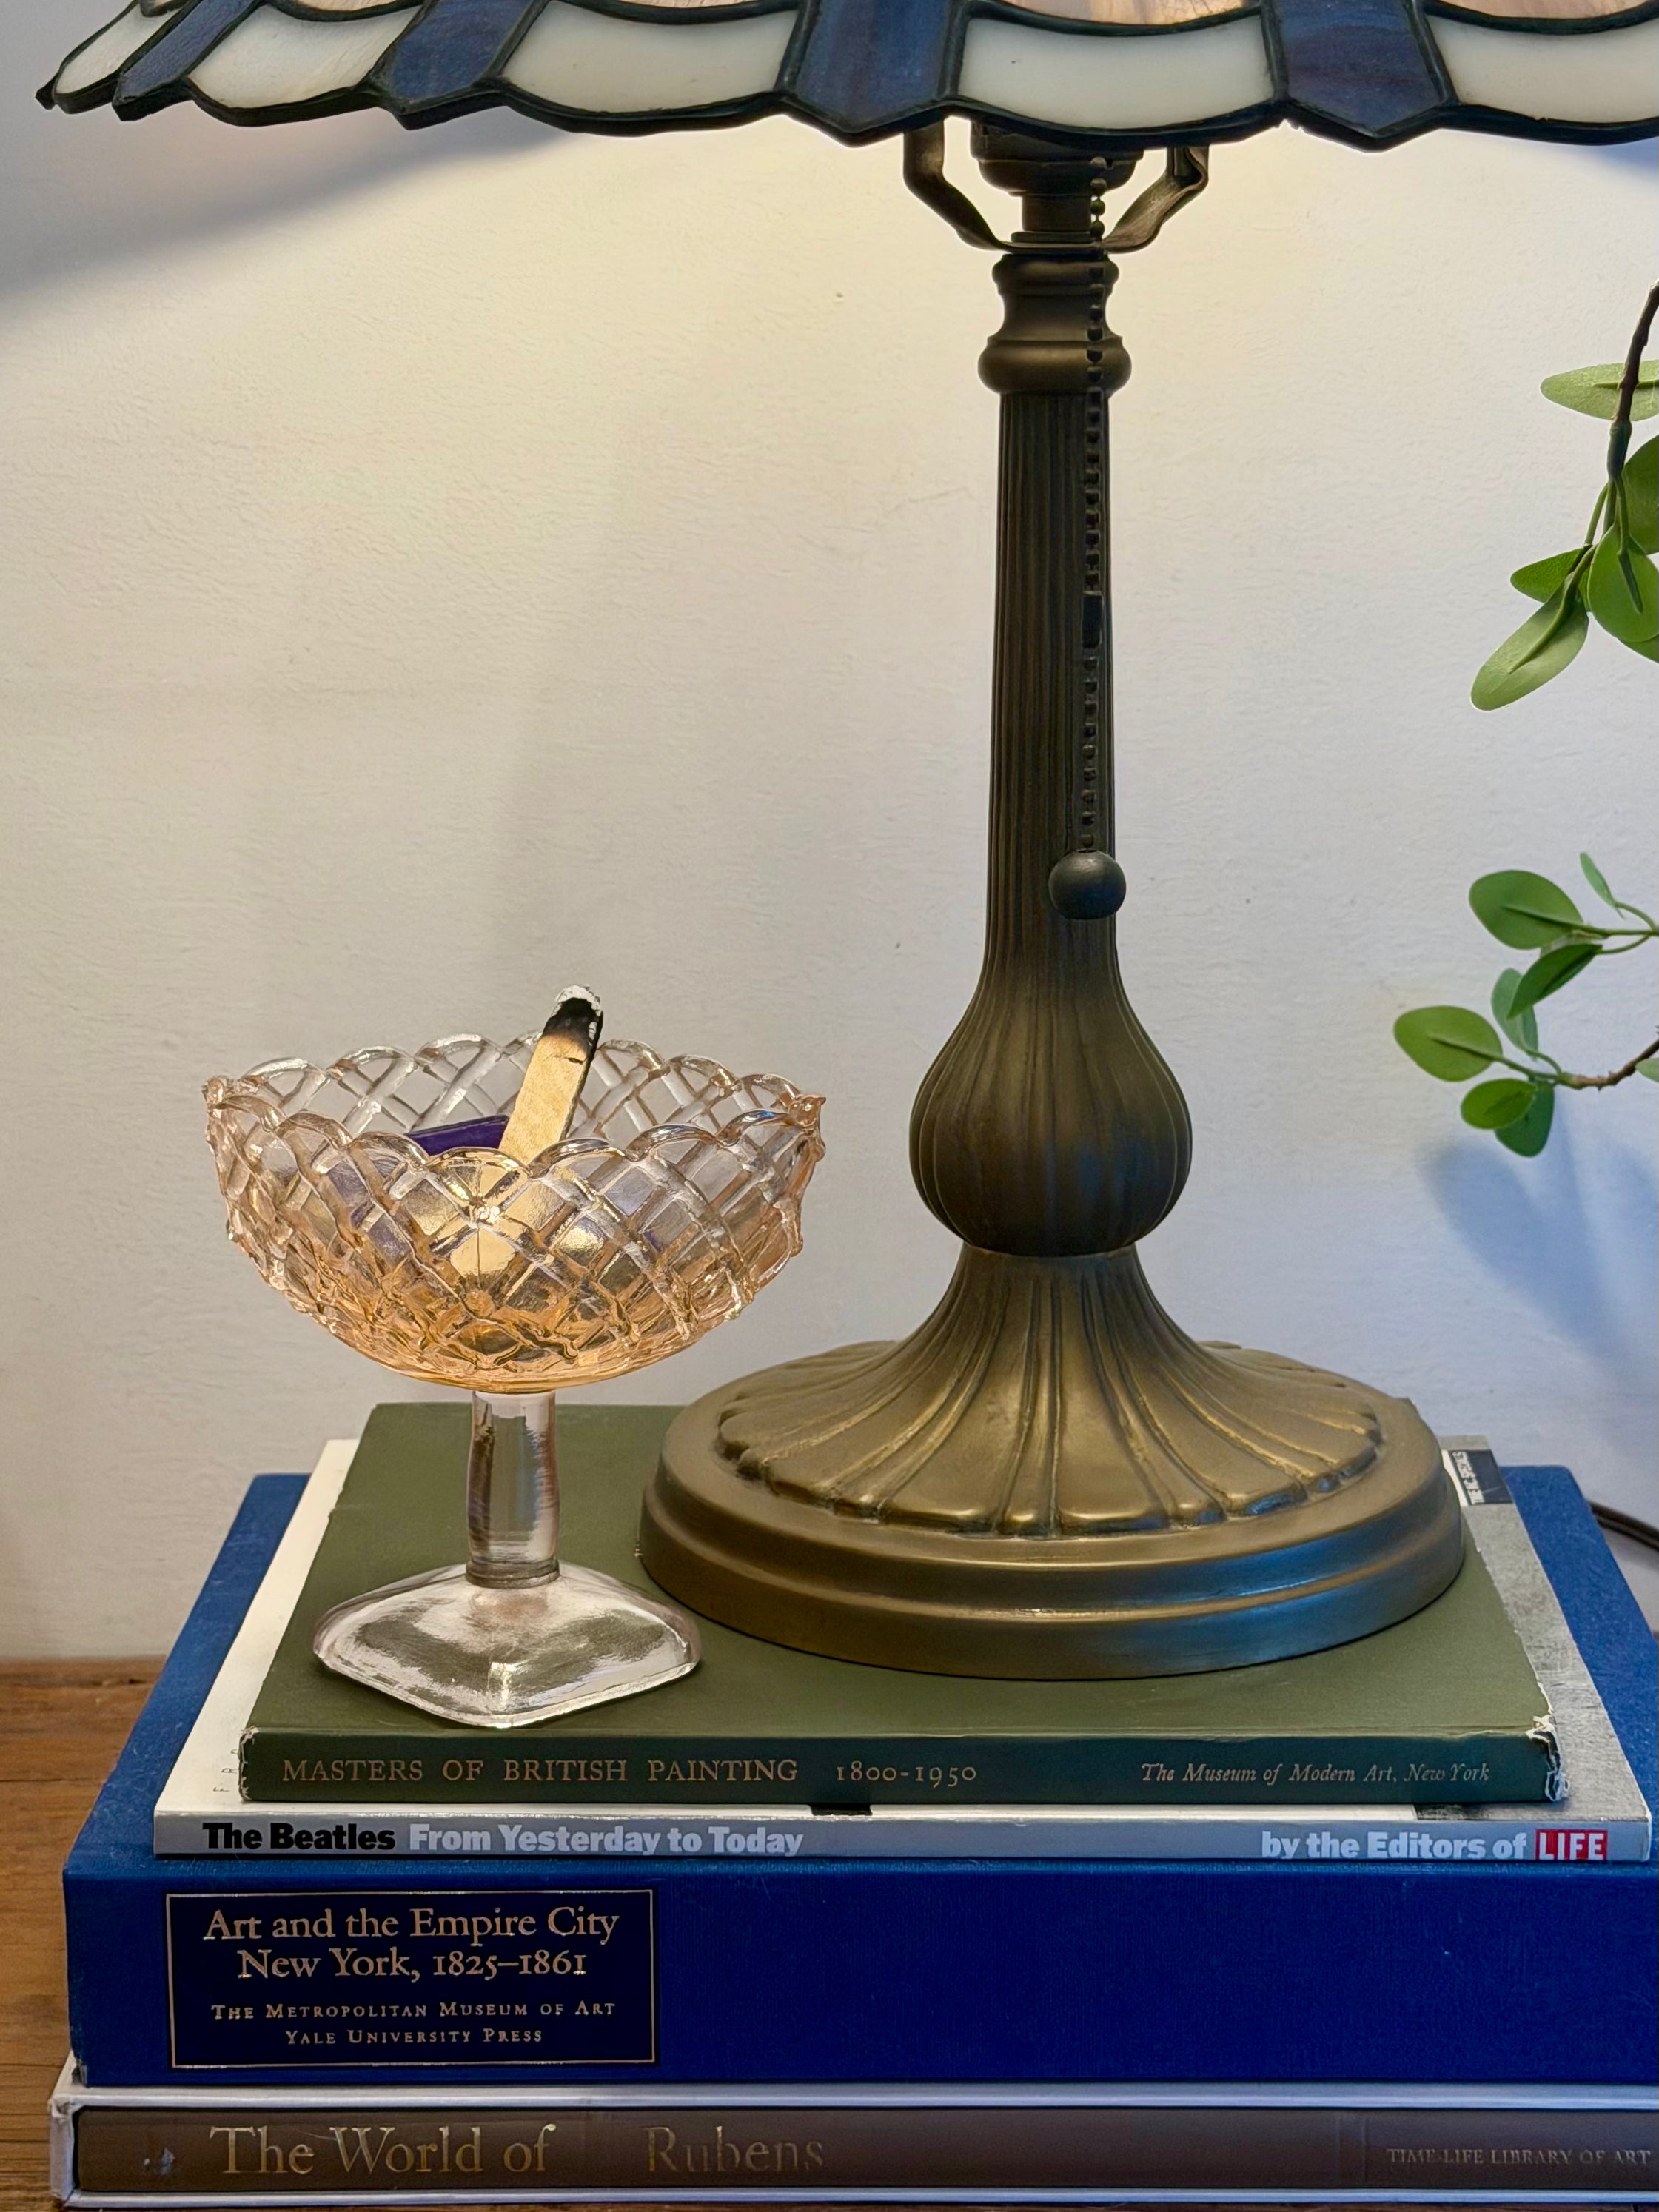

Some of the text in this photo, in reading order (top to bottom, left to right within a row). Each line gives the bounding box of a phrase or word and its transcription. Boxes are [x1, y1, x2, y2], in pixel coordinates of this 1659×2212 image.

[282, 1758, 977, 1789] MASTERS OF BRITISH PAINTING 1800-1950
[1141, 1762, 1490, 1786] The Museum of Modern Art, New York
[202, 1822, 804, 1857] The Beatles From Yesterday to Today
[1261, 1831, 1606, 1860] by the Editors of LIFE
[203, 1906, 620, 1947] Art and the Empire City
[236, 1948, 322, 1979] New
[329, 1946, 421, 1983] York,
[209, 2122, 824, 2174] The World of Rubens
[1491, 2148, 1572, 2165] LIBRARY
[1579, 2148, 1605, 2164] OF
[1614, 2148, 1652, 2166] ART
